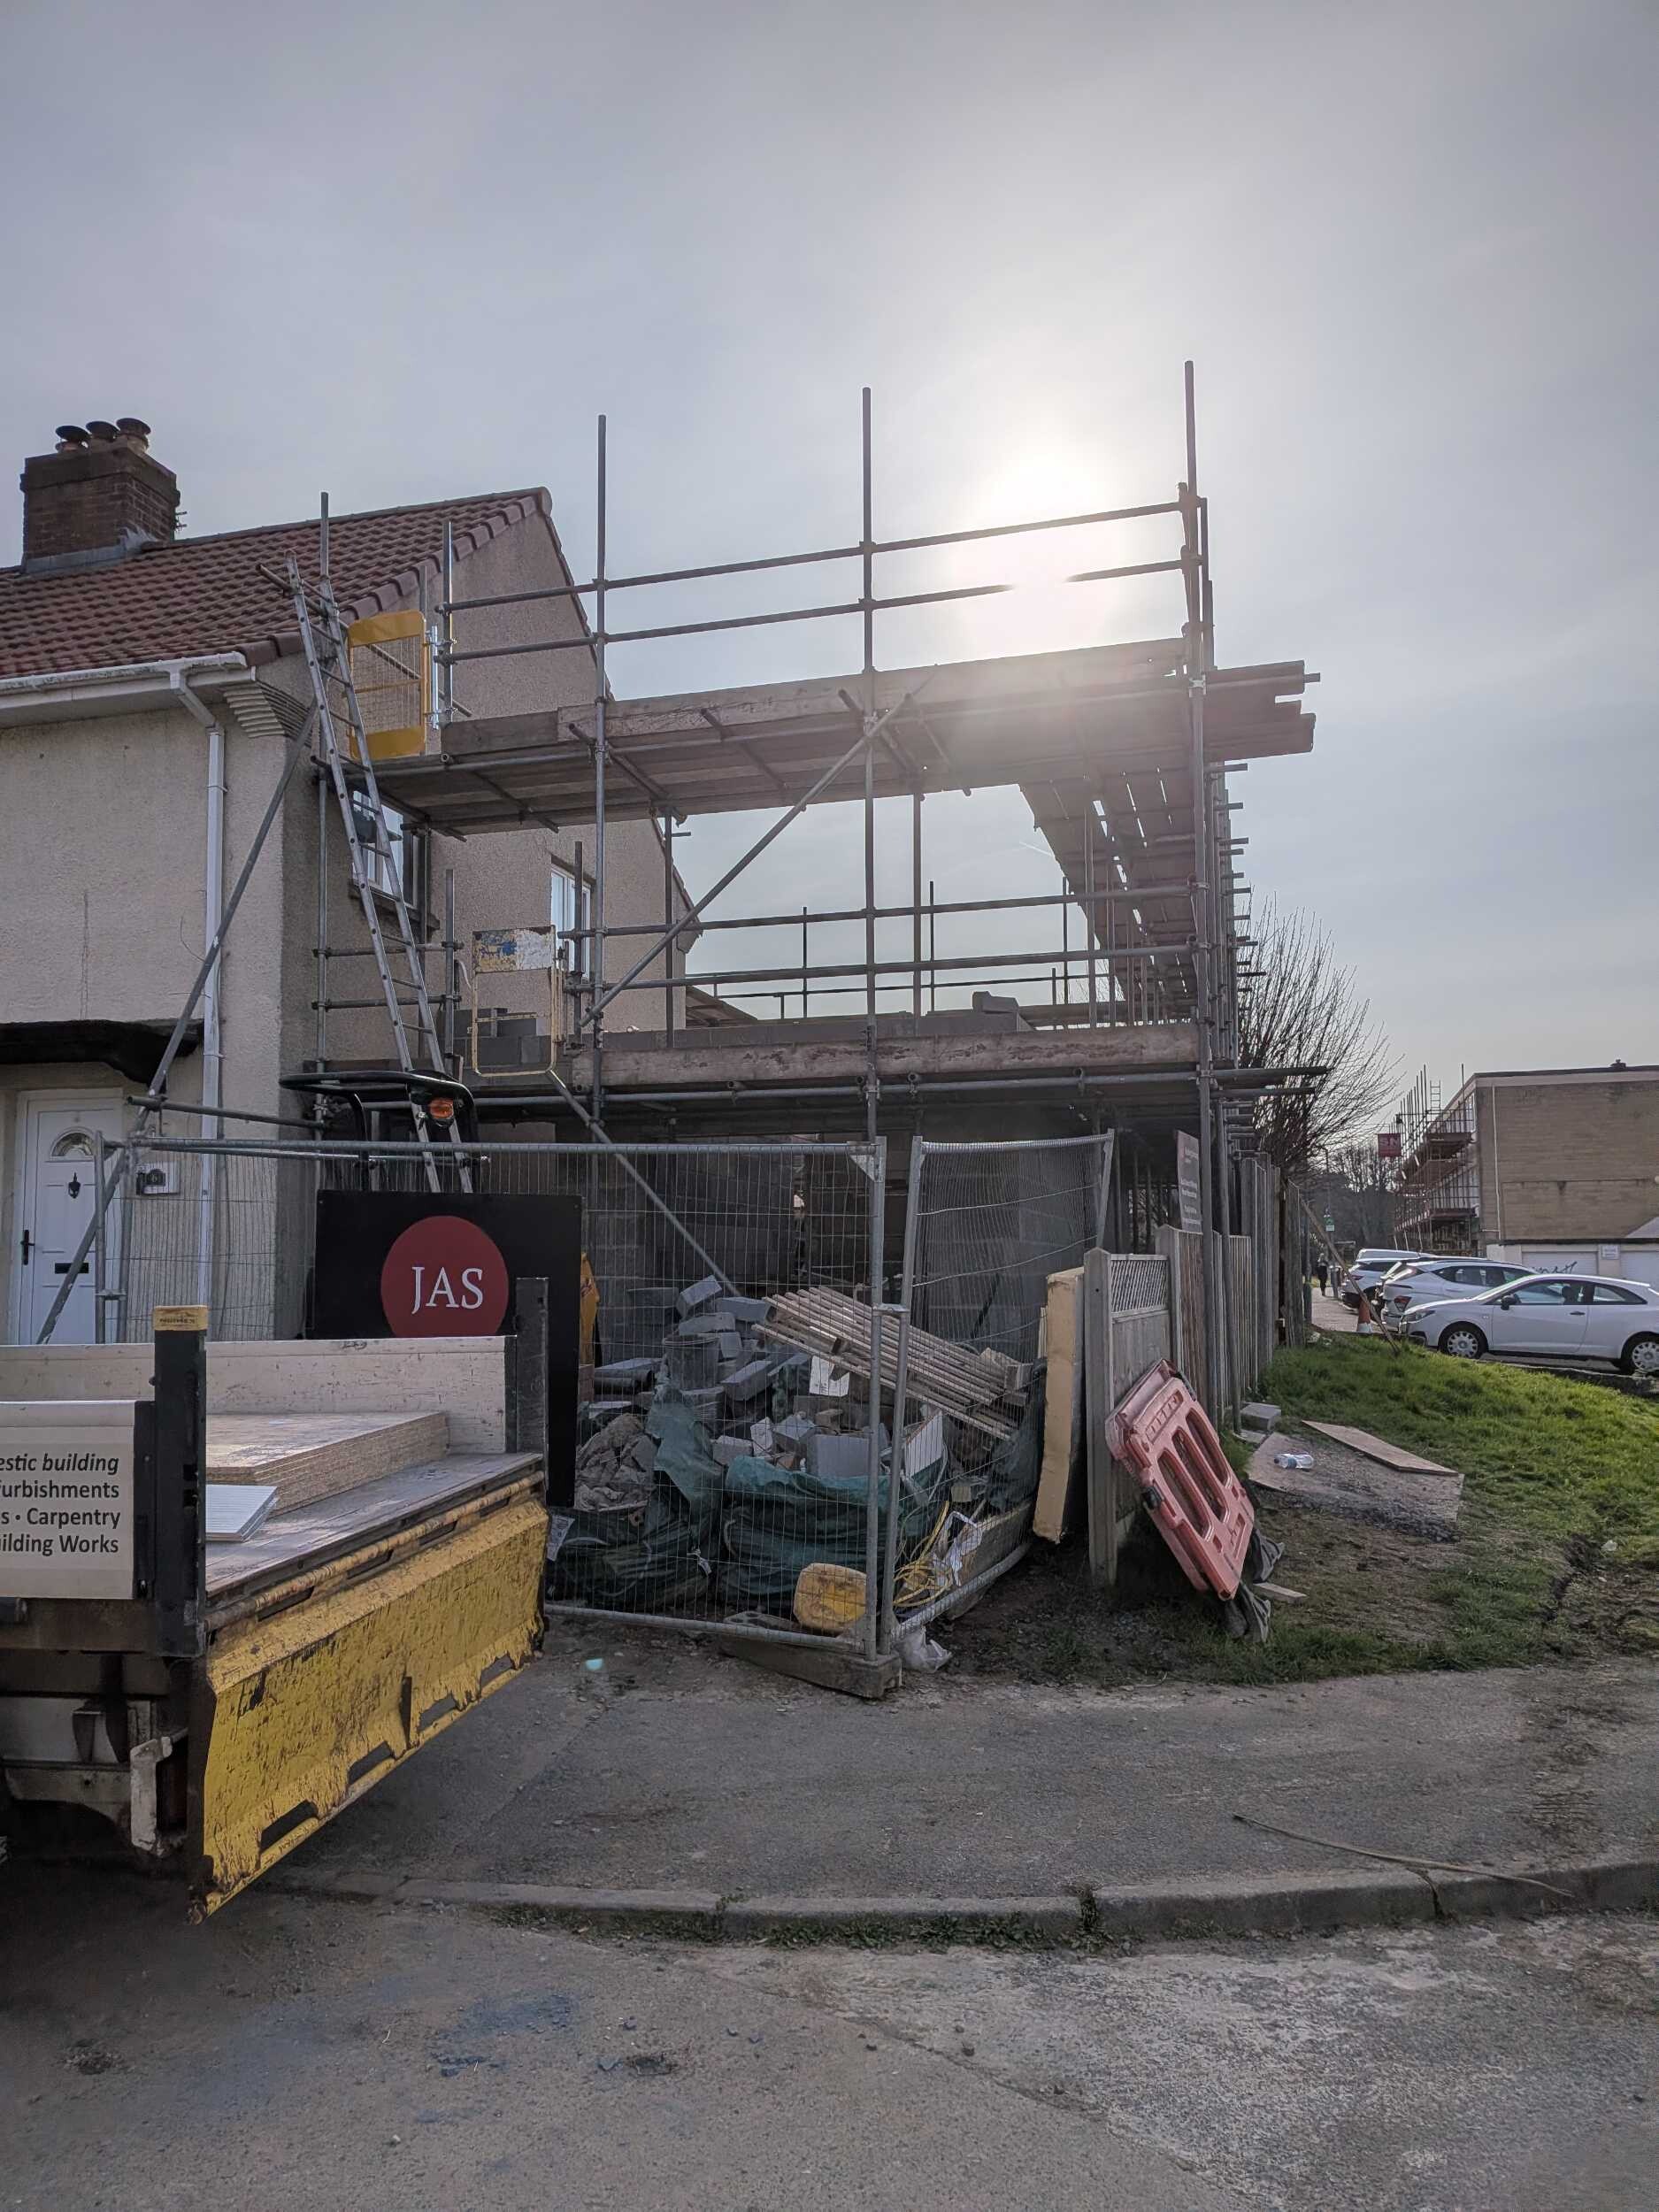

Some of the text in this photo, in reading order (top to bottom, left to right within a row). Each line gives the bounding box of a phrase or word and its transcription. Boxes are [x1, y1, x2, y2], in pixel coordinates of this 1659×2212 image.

[411, 1266, 483, 1315] JAS
[42, 1453, 119, 1476] building
[0, 1479, 120, 1499] urbishments
[27, 1507, 121, 1530] Carpentry
[0, 1532, 119, 1557] ilding Works
